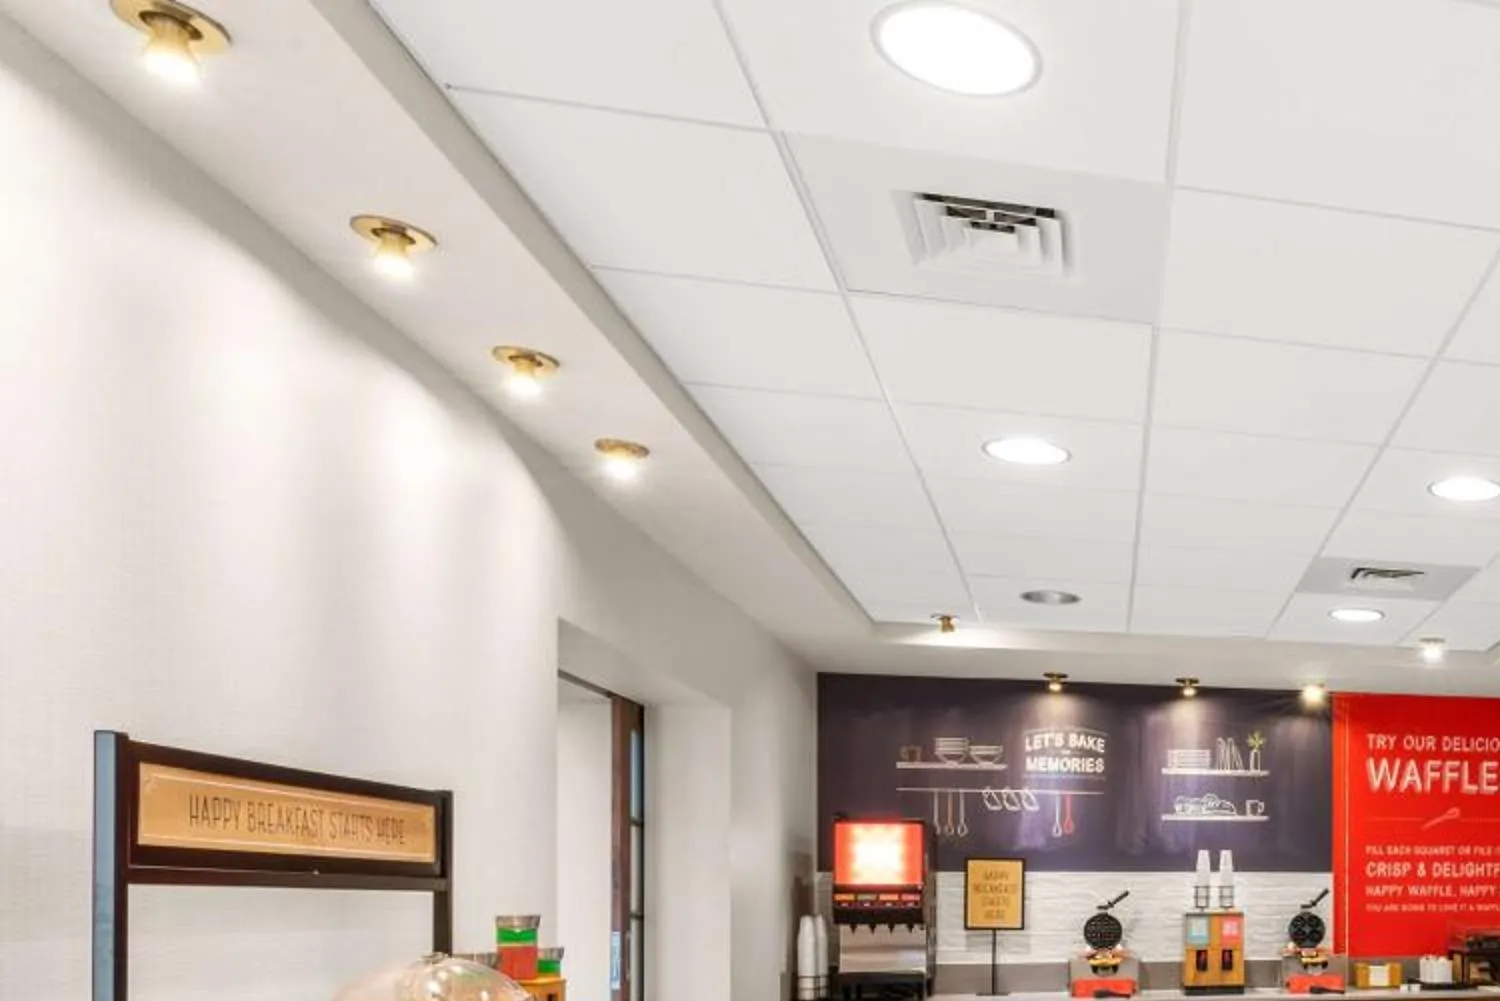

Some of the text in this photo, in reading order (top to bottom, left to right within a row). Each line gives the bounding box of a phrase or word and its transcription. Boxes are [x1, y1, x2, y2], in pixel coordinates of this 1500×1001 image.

[1025, 732, 1105, 753] LET'S BAKE
[1366, 733, 1397, 750] TRY
[1403, 735, 1437, 751] OUR
[1025, 757, 1105, 773] MEMORIES
[188, 793, 405, 845] HAPPY BREAKFAST STARTS HERE
[1365, 861, 1411, 878] CRISP
[1417, 861, 1427, 878] &
[1365, 884, 1403, 897] HAPPY
[1460, 885, 1495, 898] HAPPY
